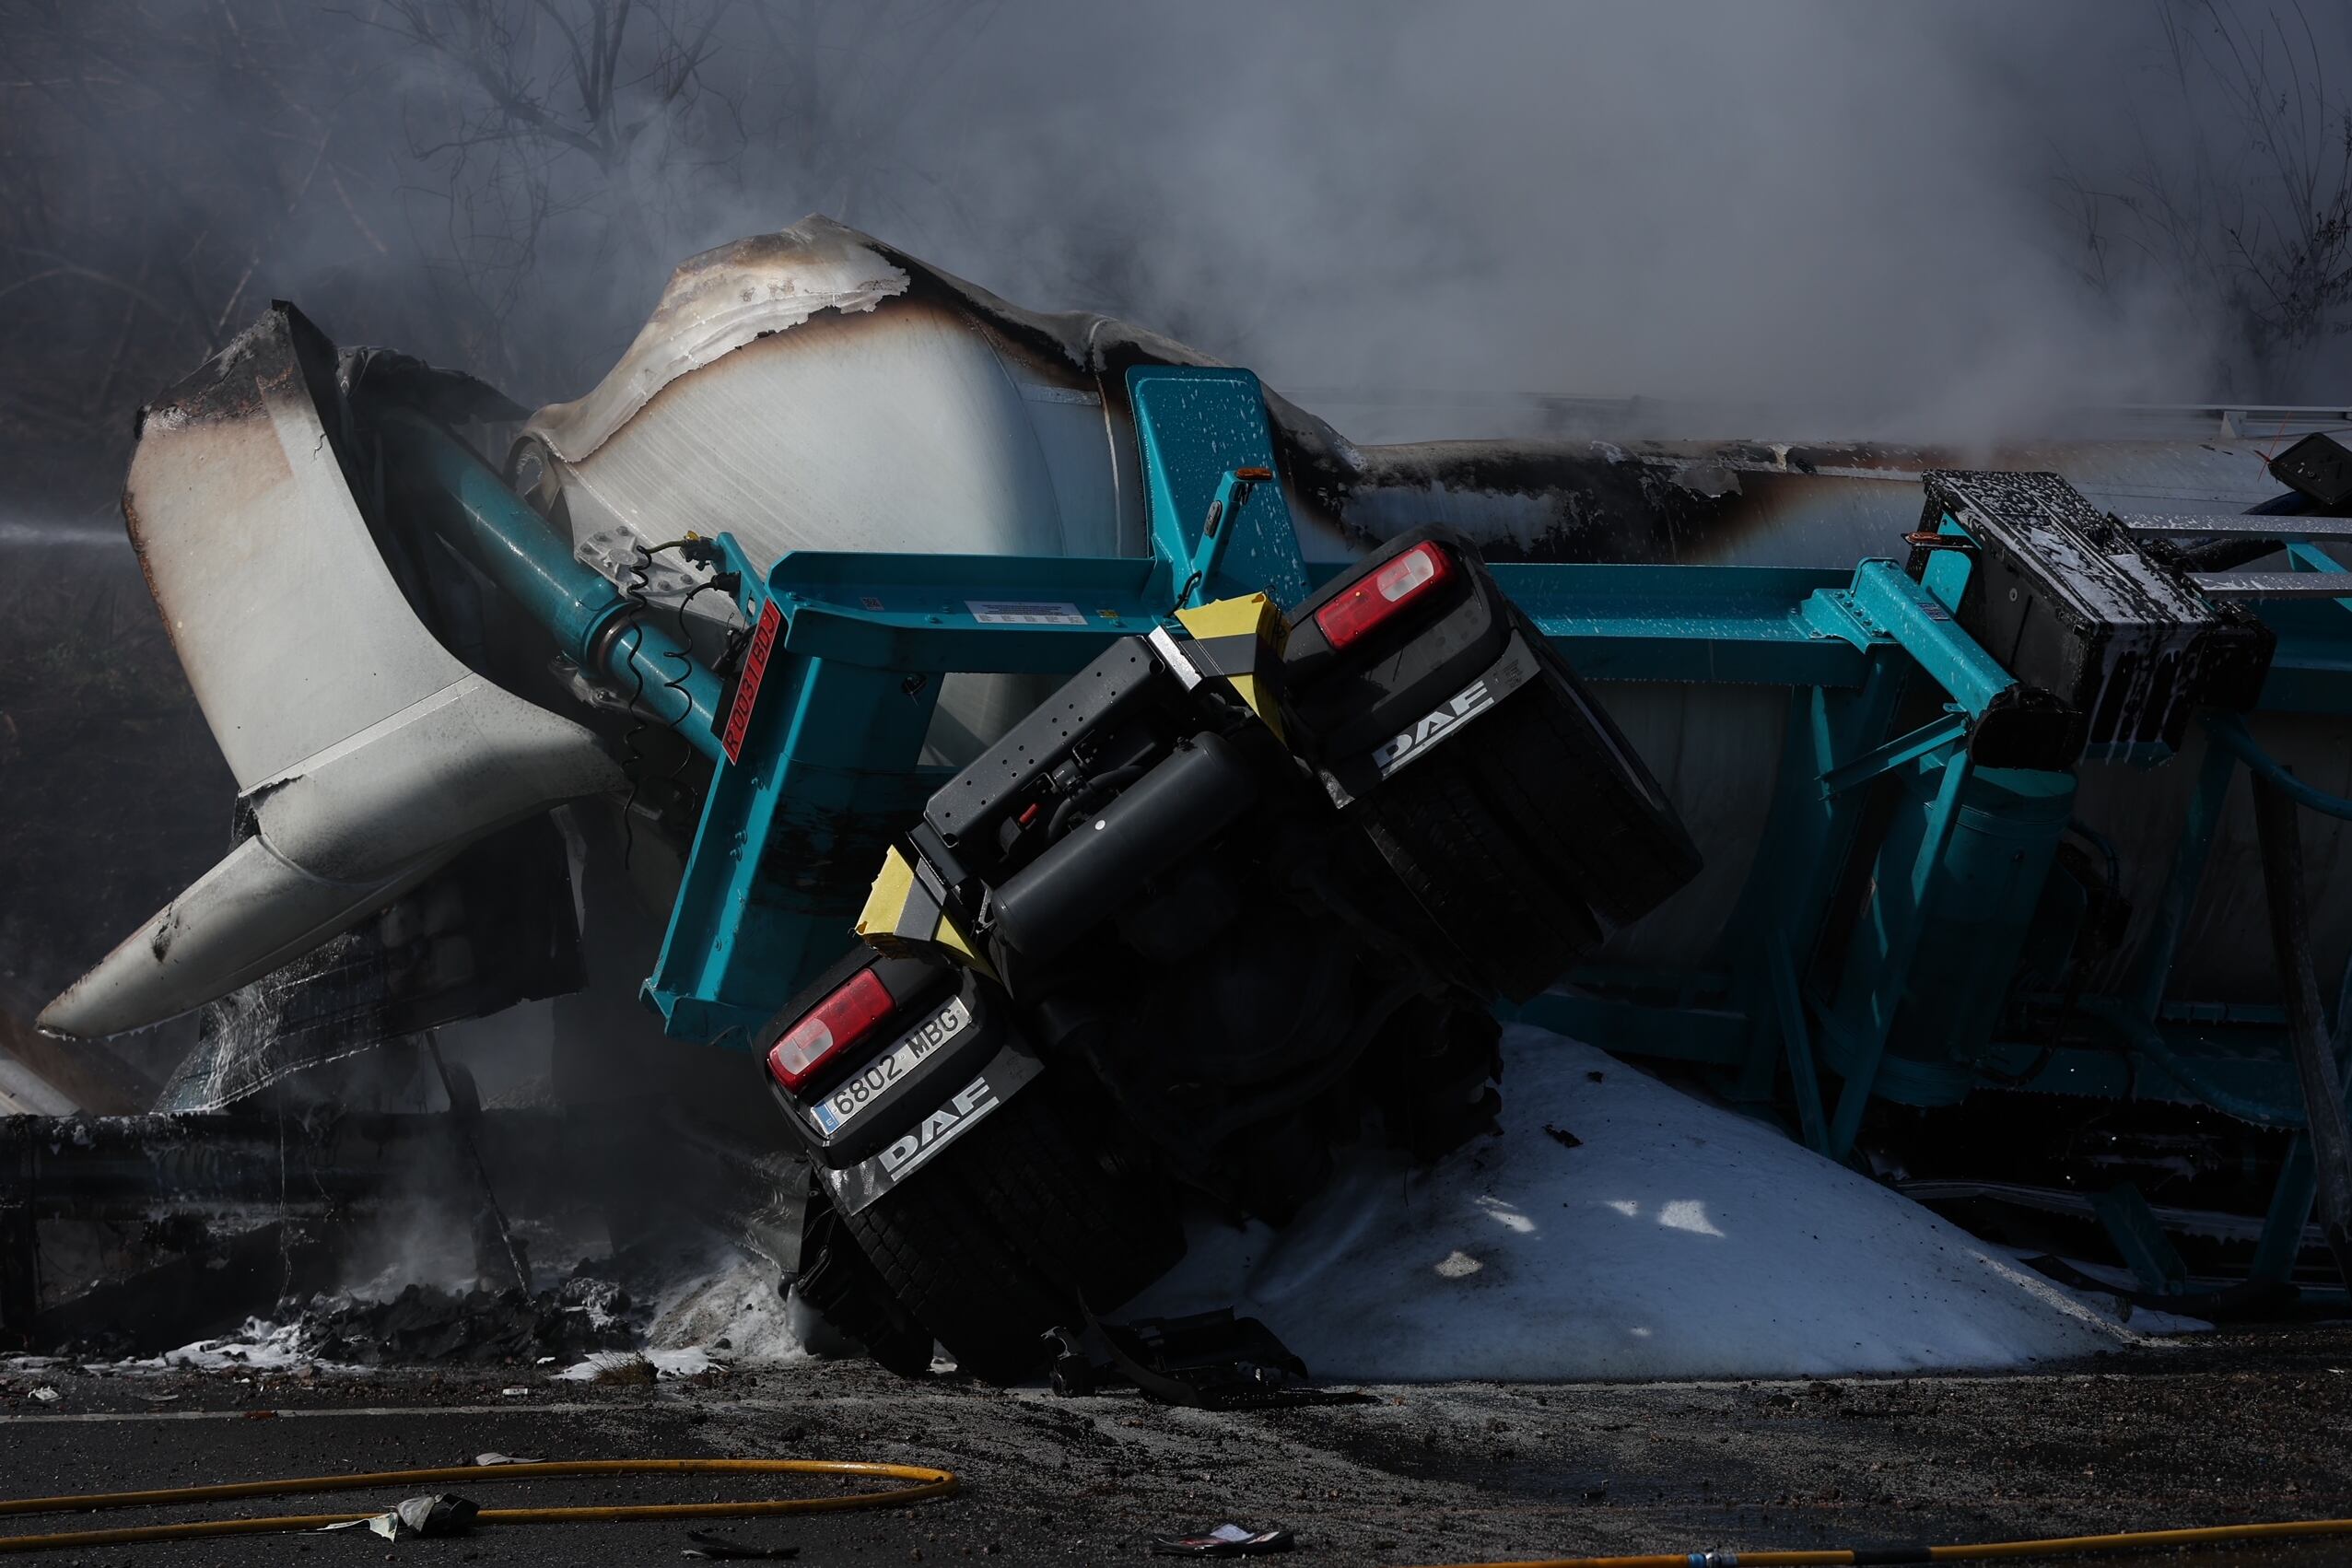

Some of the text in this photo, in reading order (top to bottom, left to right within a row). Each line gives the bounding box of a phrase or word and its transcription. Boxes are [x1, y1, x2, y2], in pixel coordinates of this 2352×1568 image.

[725, 607, 775, 755] R 0031 BDJ
[1371, 680, 1488, 769] DAF
[833, 1054, 903, 1115] 6802
[905, 1008, 959, 1059] MBG
[878, 1076, 990, 1173] DAF
